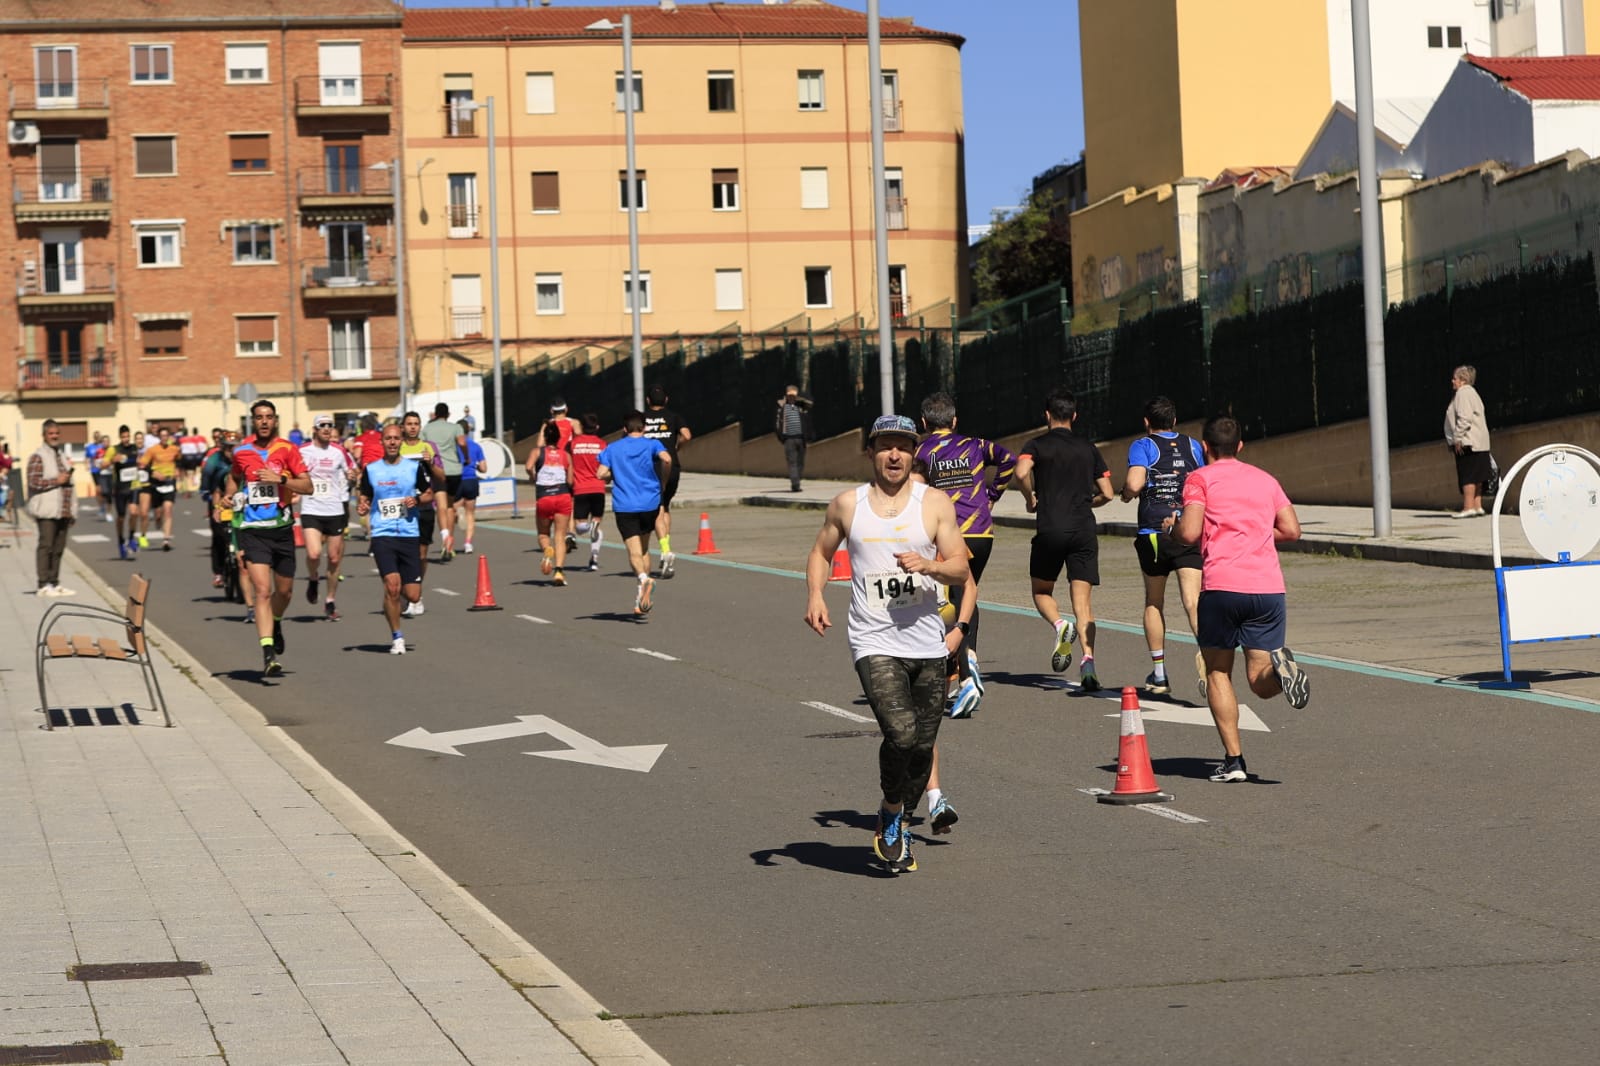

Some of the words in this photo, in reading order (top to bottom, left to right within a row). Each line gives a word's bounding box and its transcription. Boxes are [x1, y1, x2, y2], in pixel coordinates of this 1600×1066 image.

[937, 457, 970, 470] PRIM
[251, 485, 274, 498] 288
[382, 503, 403, 515] 587
[873, 575, 916, 600] 194
